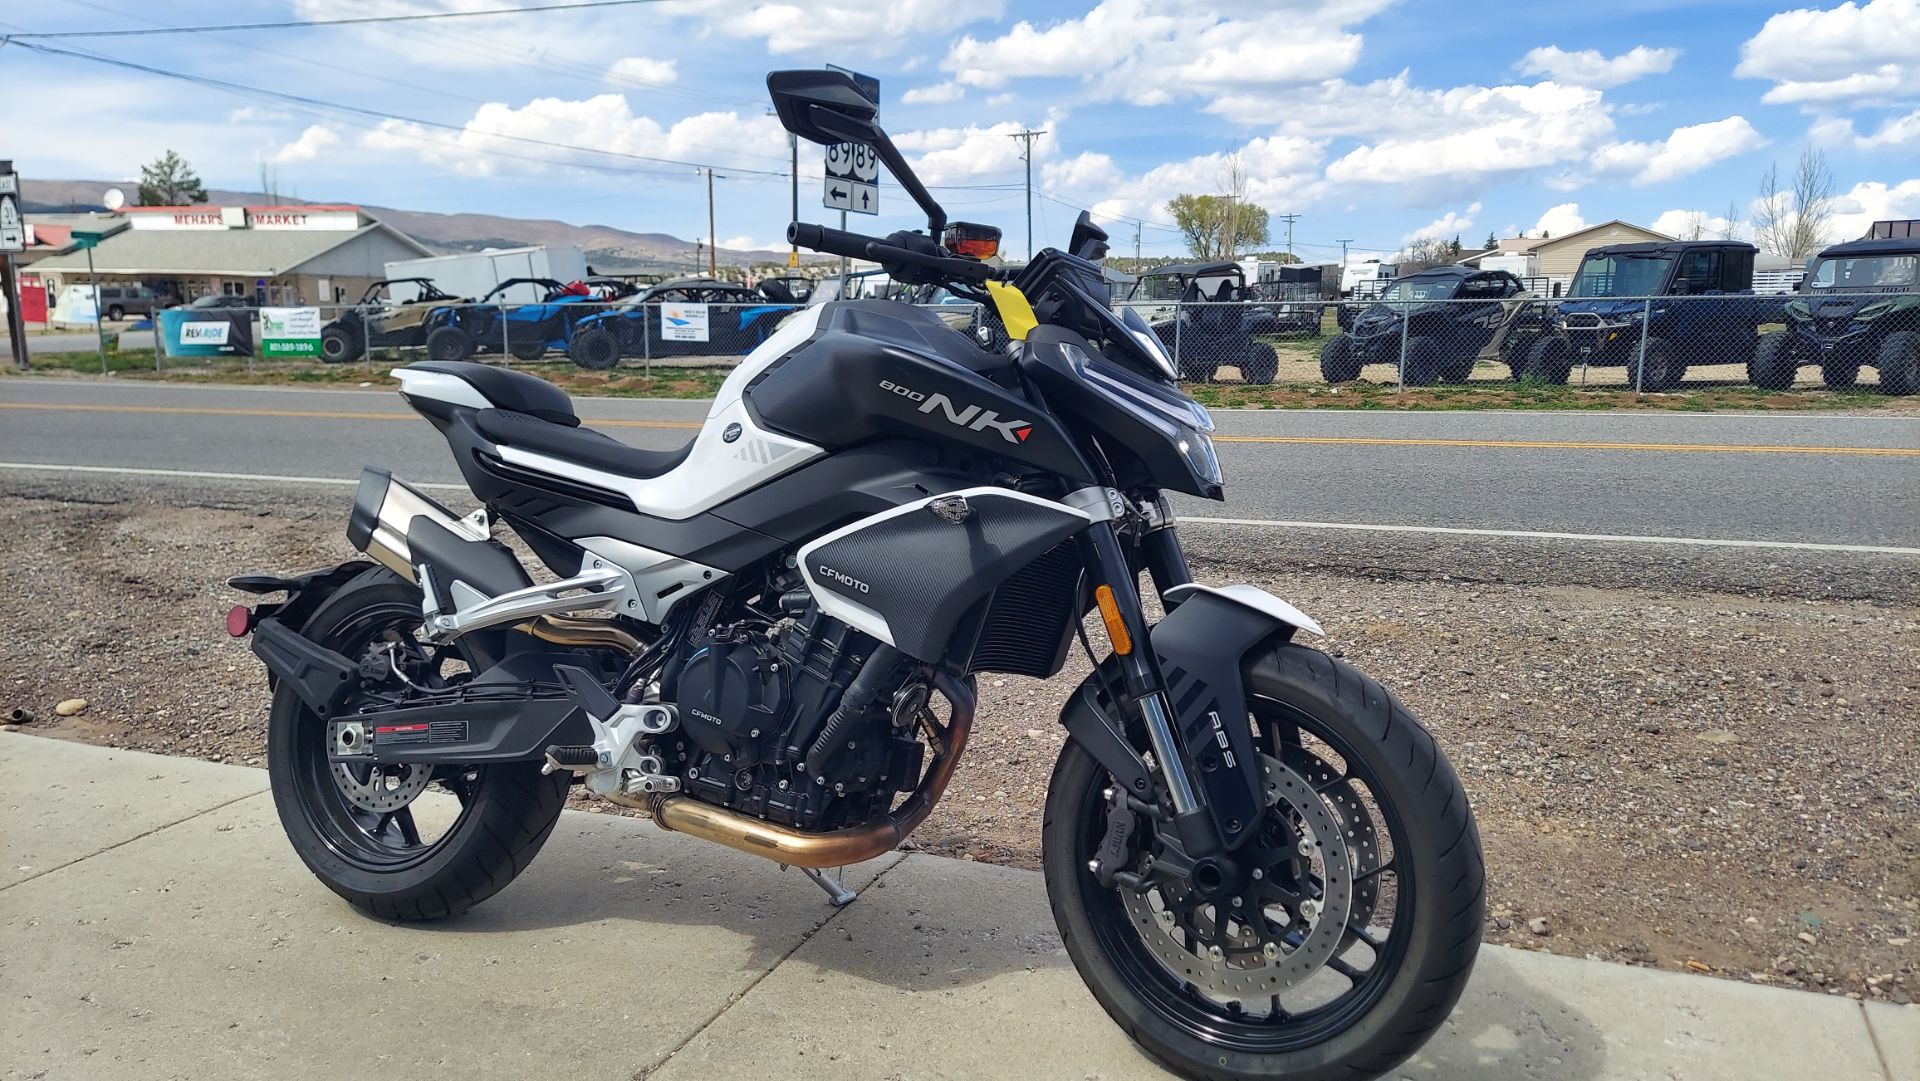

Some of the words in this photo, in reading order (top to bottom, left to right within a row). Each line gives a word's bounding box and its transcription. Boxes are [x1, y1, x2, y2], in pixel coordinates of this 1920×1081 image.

[174, 214, 224, 225] MEHAR'S
[255, 214, 308, 225] MARKET
[878, 379, 926, 402] 800
[917, 392, 1033, 445] NK
[819, 565, 870, 594] CFMOTO
[691, 708, 722, 725] CFMOTO
[1208, 711, 1236, 768] ABS
